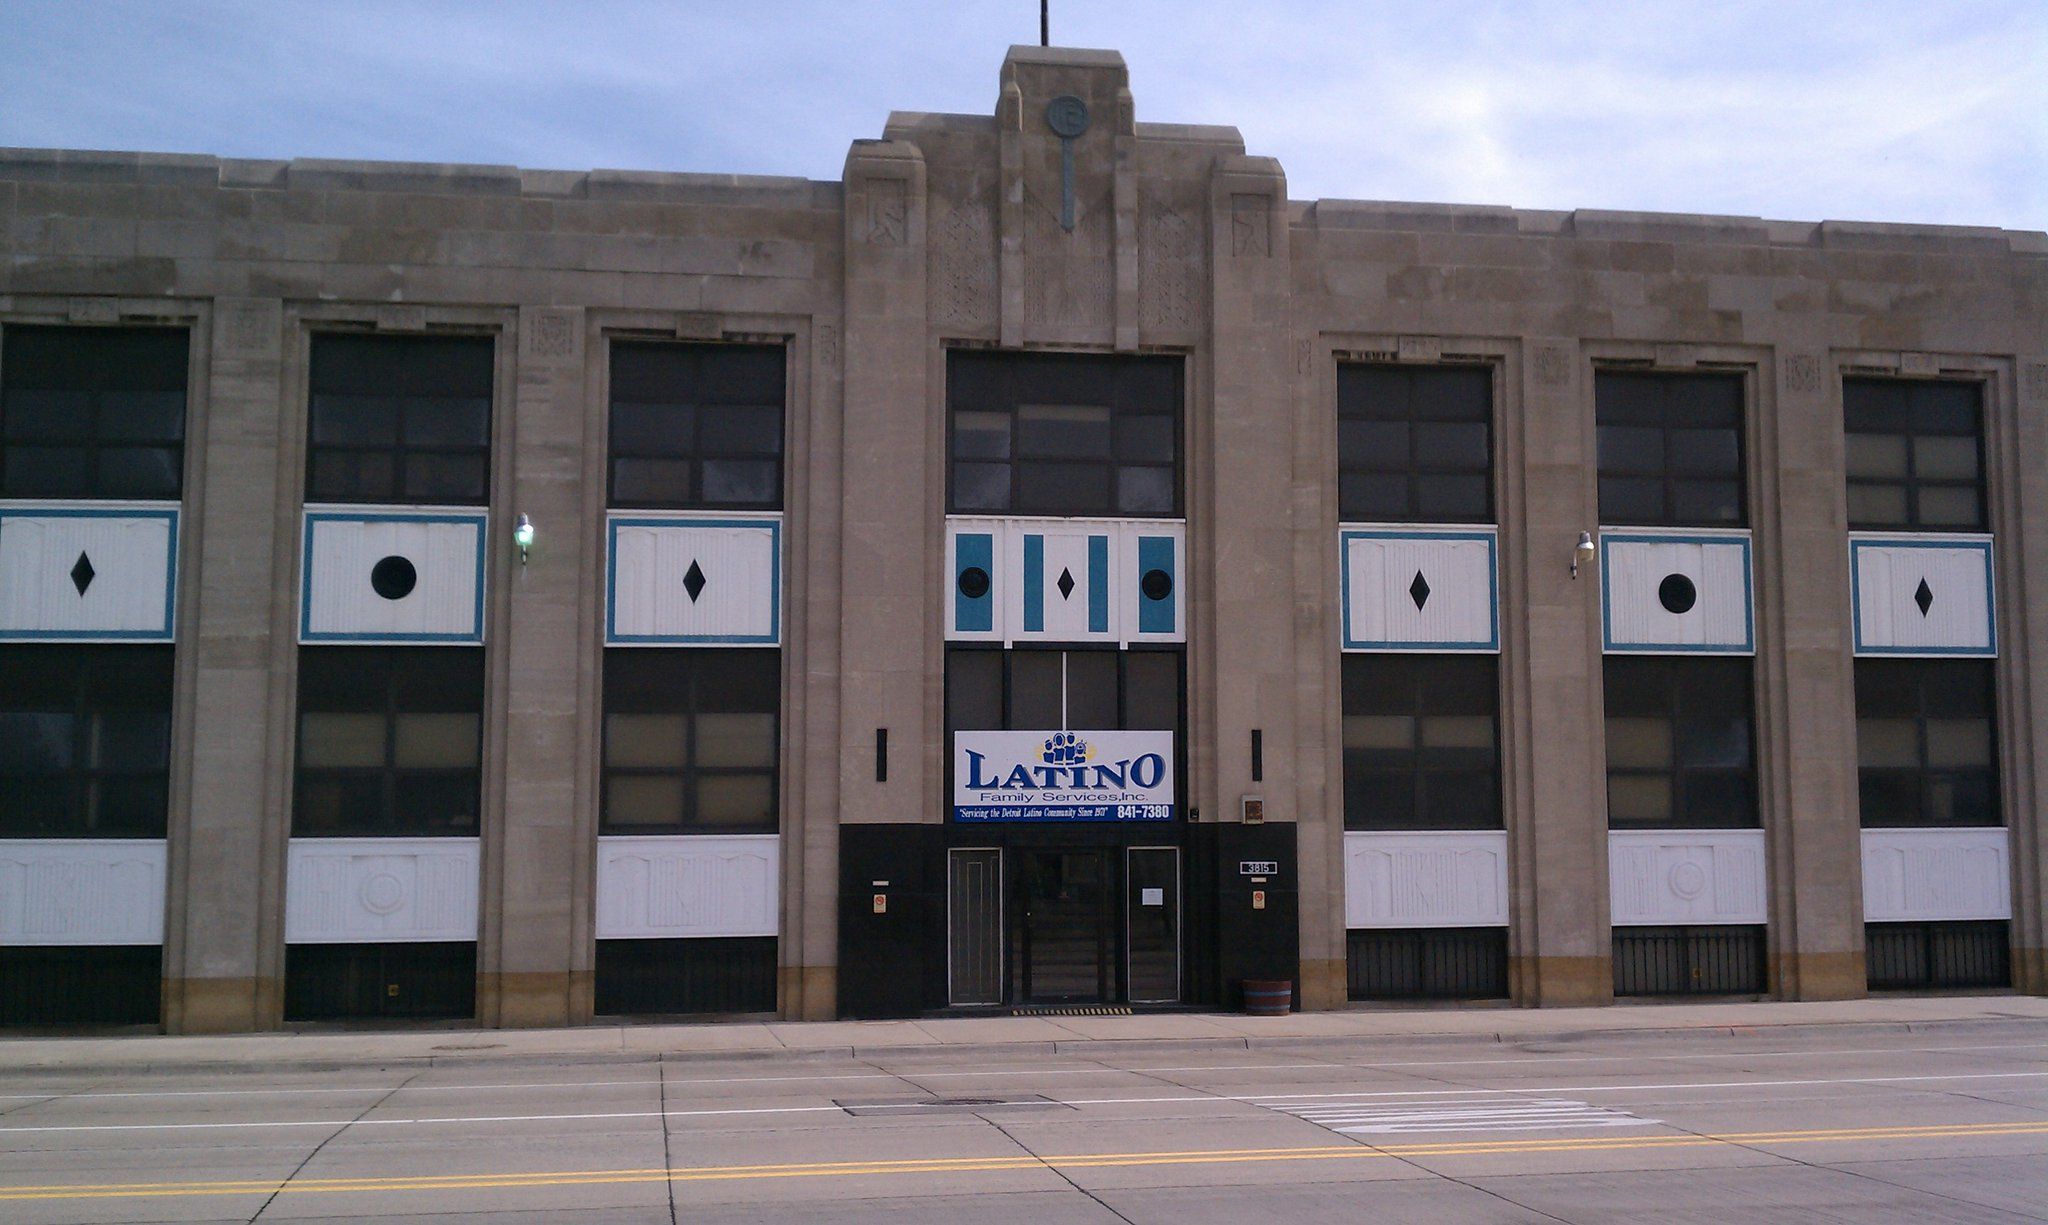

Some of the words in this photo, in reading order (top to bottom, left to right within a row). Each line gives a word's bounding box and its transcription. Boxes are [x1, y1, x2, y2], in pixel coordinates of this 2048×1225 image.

[965, 749, 1166, 789] LATINO
[980, 793, 1034, 802] Family
[991, 808, 1000, 818] the
[1001, 808, 1022, 818] Detroit
[1023, 808, 1042, 818] Latino
[1044, 808, 1076, 819] Community
[1078, 807, 1093, 817] Since
[1117, 805, 1169, 818] 841-7380
[1248, 863, 1269, 872] 3815
